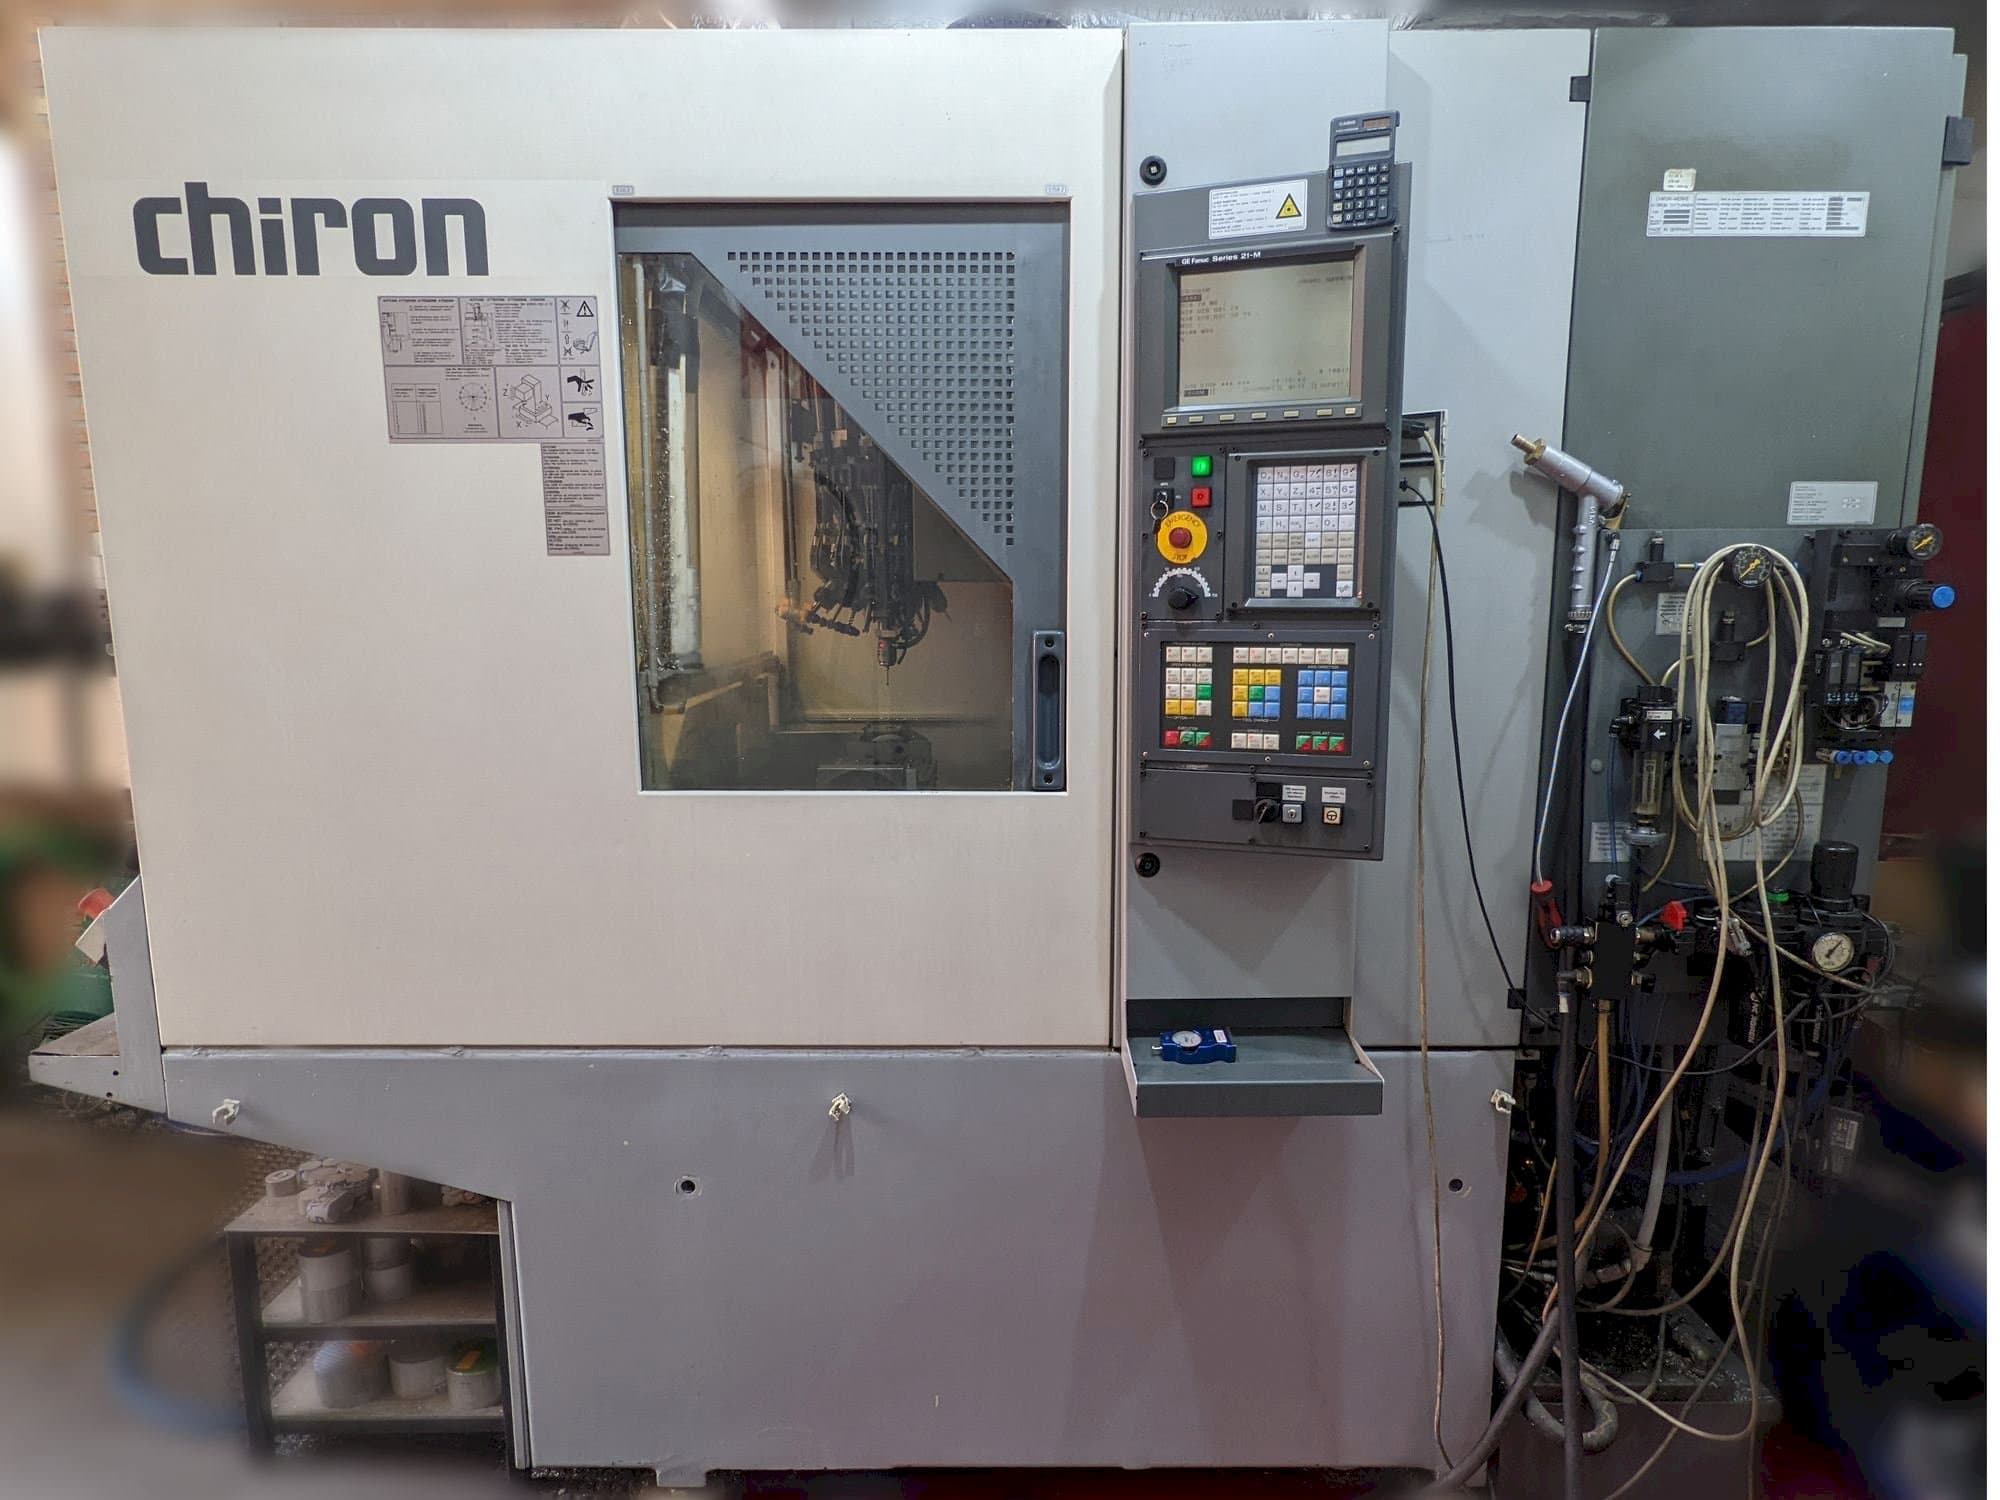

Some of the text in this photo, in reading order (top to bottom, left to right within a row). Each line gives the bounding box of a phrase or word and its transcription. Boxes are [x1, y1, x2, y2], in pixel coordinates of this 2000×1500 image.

[133, 182, 489, 276] chiron
[1212, 254, 1239, 262] Series
[1240, 251, 1261, 260] 21-M
